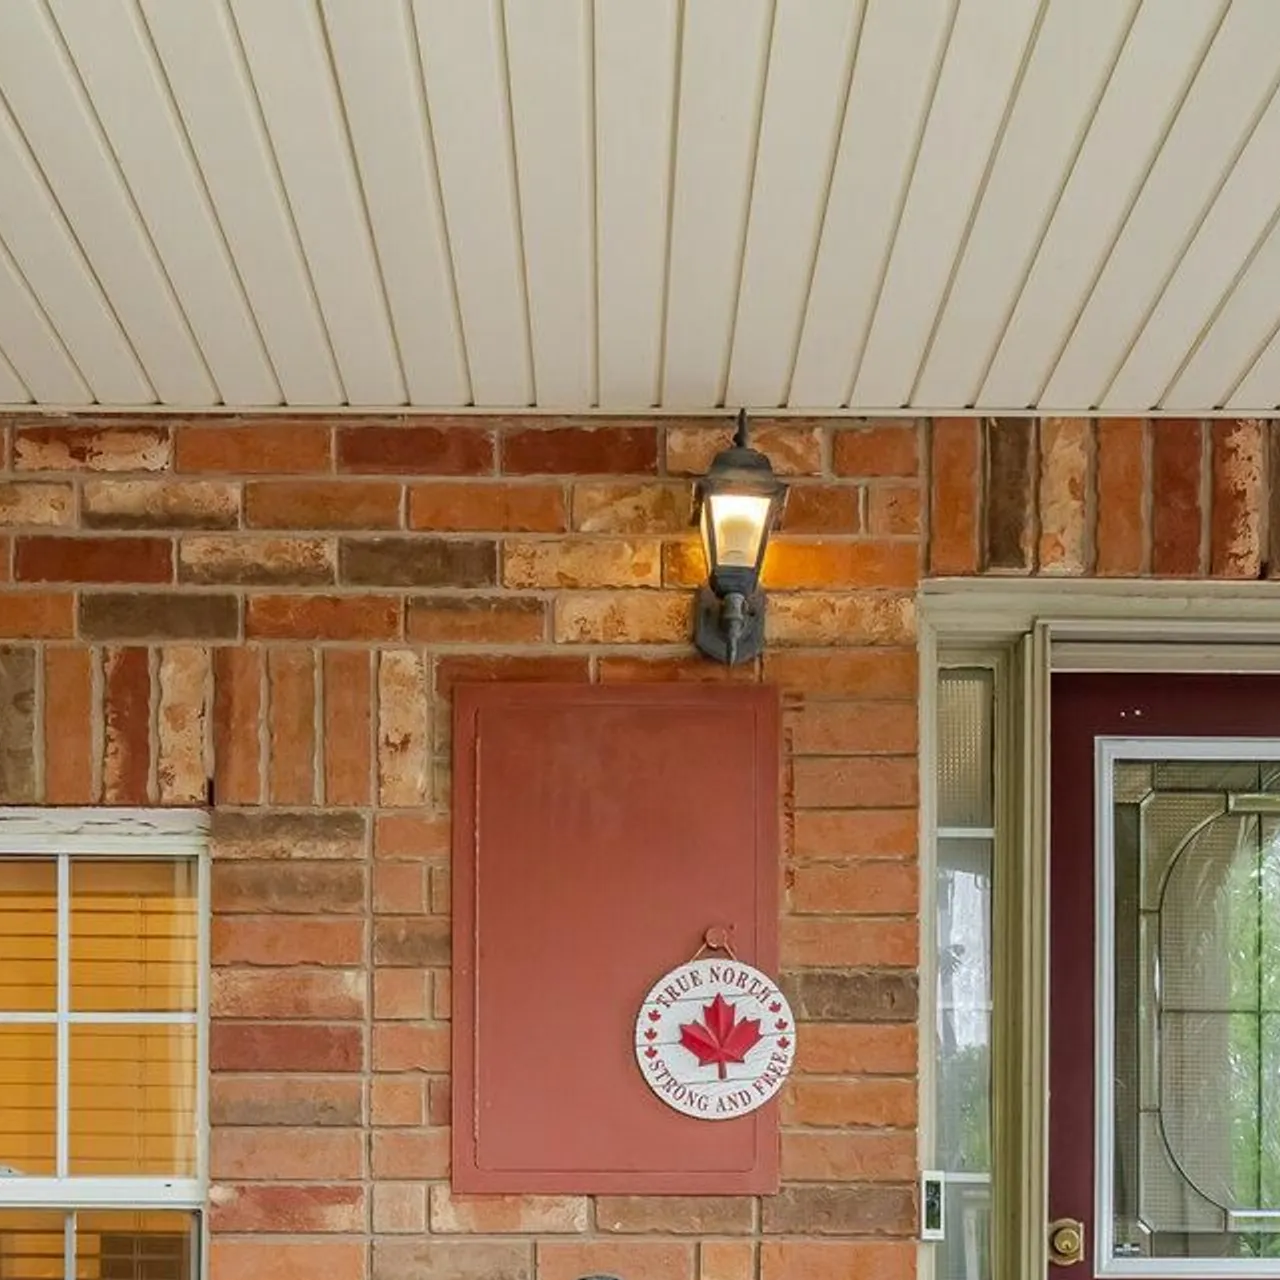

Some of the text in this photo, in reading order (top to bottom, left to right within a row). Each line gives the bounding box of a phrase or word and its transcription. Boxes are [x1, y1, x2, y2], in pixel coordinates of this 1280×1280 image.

[656, 966, 771, 1009] TRUE NORTH
[649, 1052, 788, 1112] STRONG AND FREE
